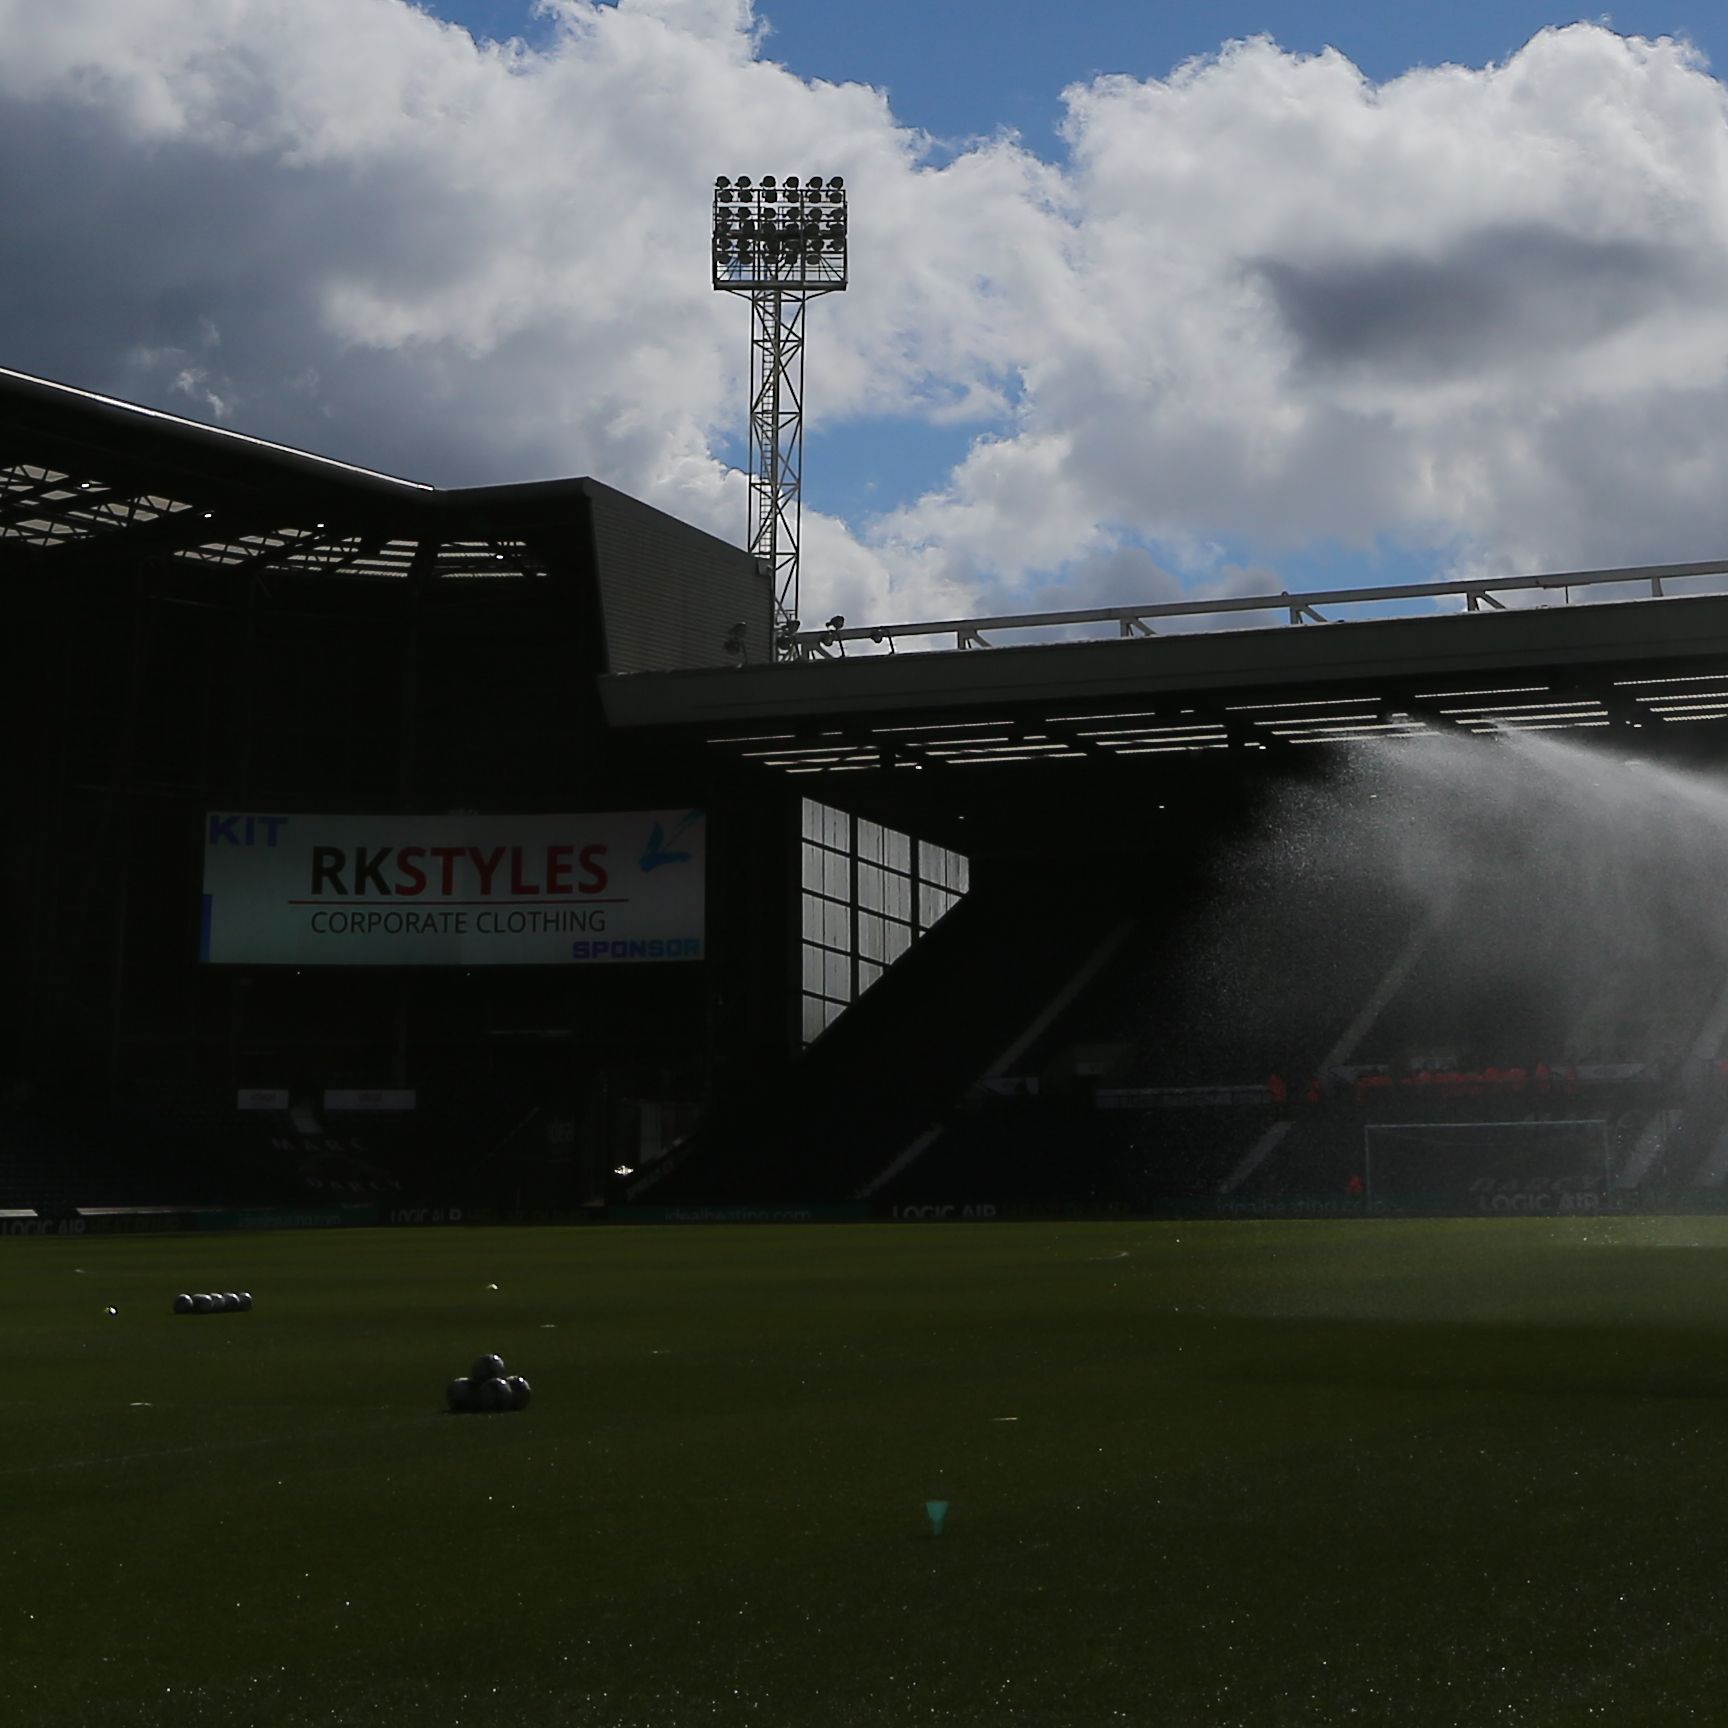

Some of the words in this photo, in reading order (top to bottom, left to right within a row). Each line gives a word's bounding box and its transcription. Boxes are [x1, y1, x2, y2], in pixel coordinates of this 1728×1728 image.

[209, 814, 289, 847] KIT
[310, 843, 610, 896] RKSTYLES
[310, 912, 467, 934] CORPORATE
[475, 909, 607, 933] CLOTHING
[572, 938, 702, 960] SPONSOR
[892, 1203, 955, 1218] LOGIC
[961, 1203, 997, 1218] AIR
[1479, 1191, 1552, 1210] LOGIC
[1558, 1191, 1601, 1210] AIR
[1, 1220, 54, 1236] LOGIC
